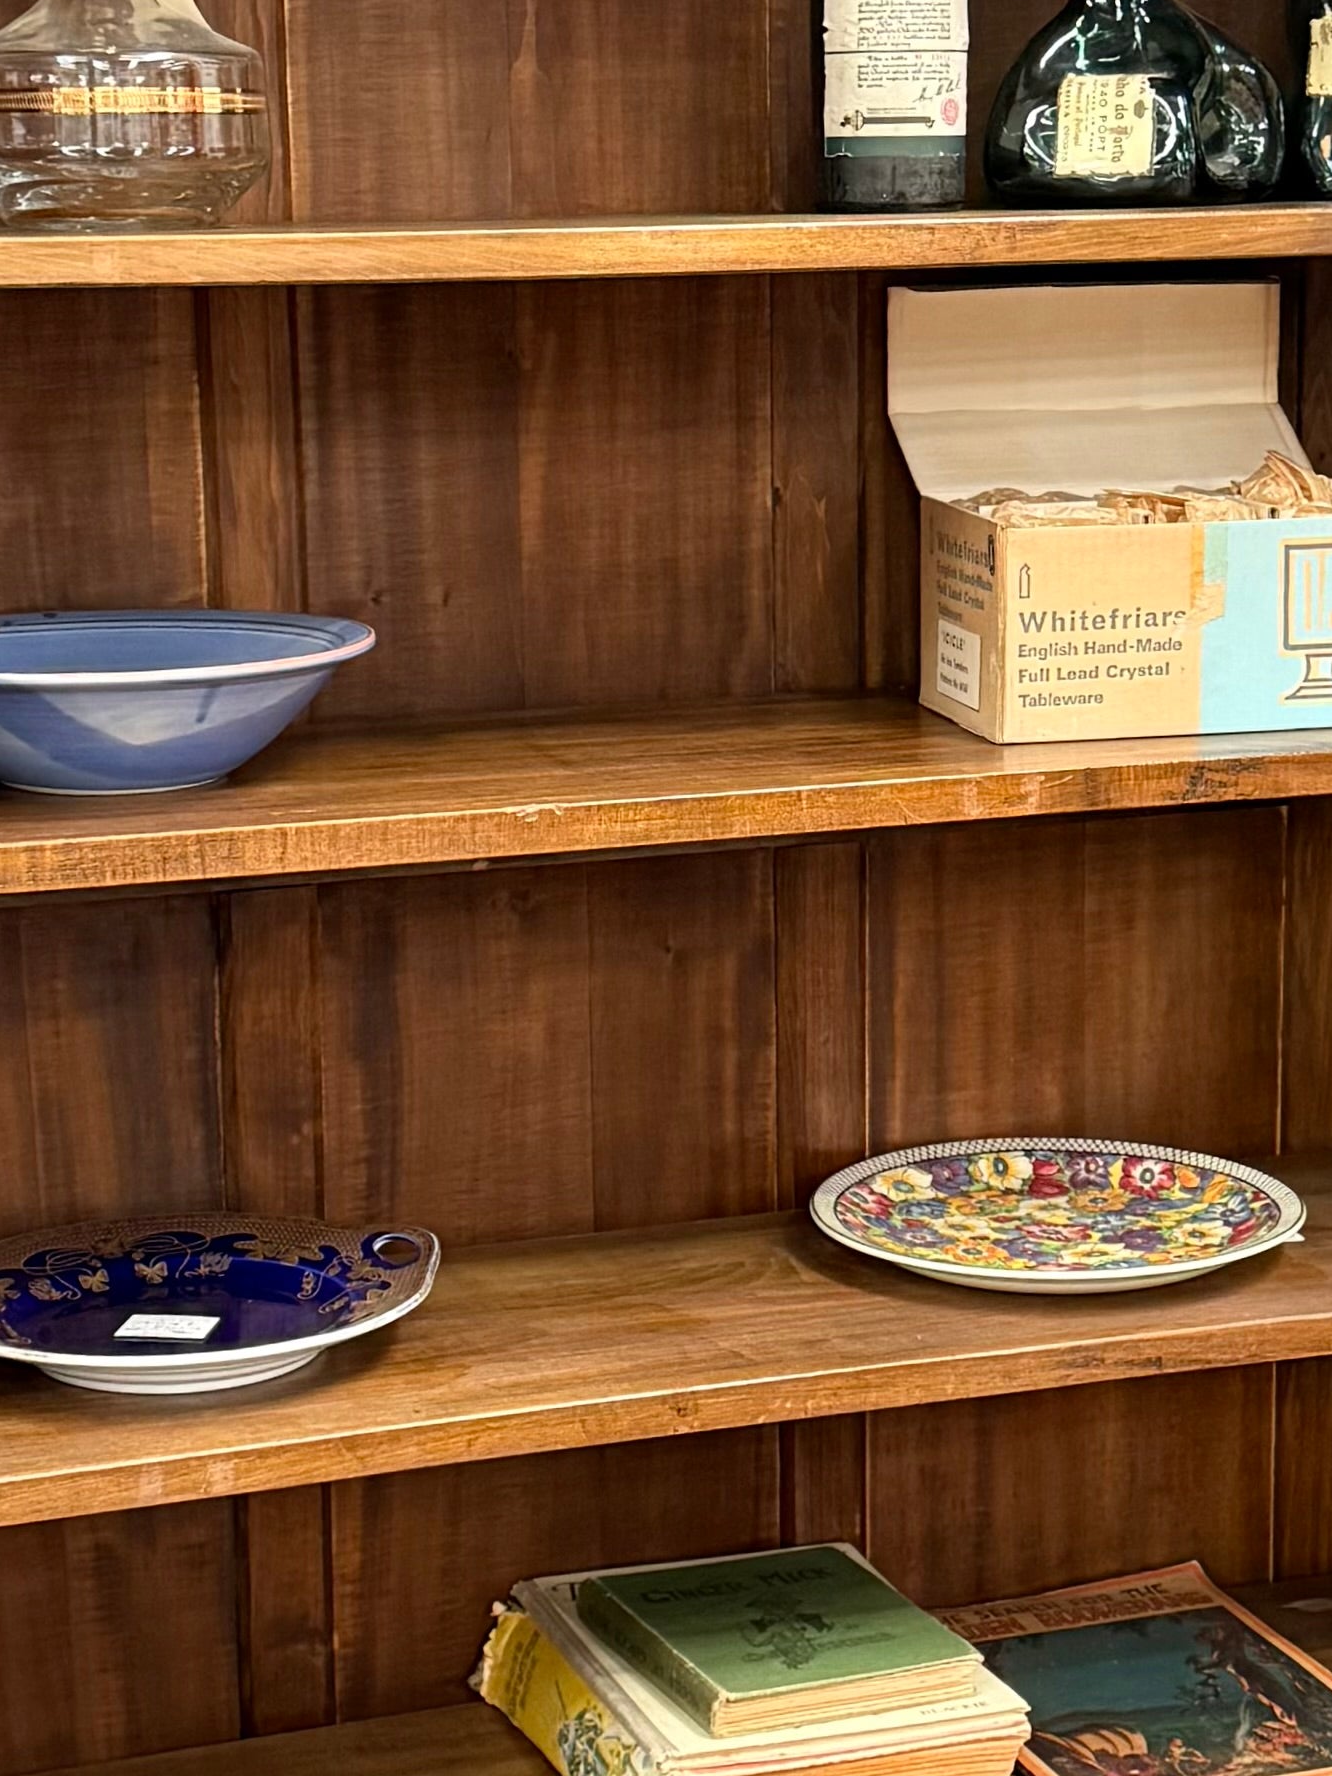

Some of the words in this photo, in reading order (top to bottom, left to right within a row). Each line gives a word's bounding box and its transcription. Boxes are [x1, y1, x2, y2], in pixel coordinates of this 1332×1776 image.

[1018, 607, 1186, 634] Whitefriars
[1018, 642, 1079, 661] English
[1084, 637, 1183, 655] Hand-Made
[1018, 668, 1050, 684] Full
[1057, 665, 1099, 681] Lead
[1106, 661, 1170, 680] Crystal
[1018, 693, 1104, 708] Tableware
[1120, 1583, 1171, 1599] THE
